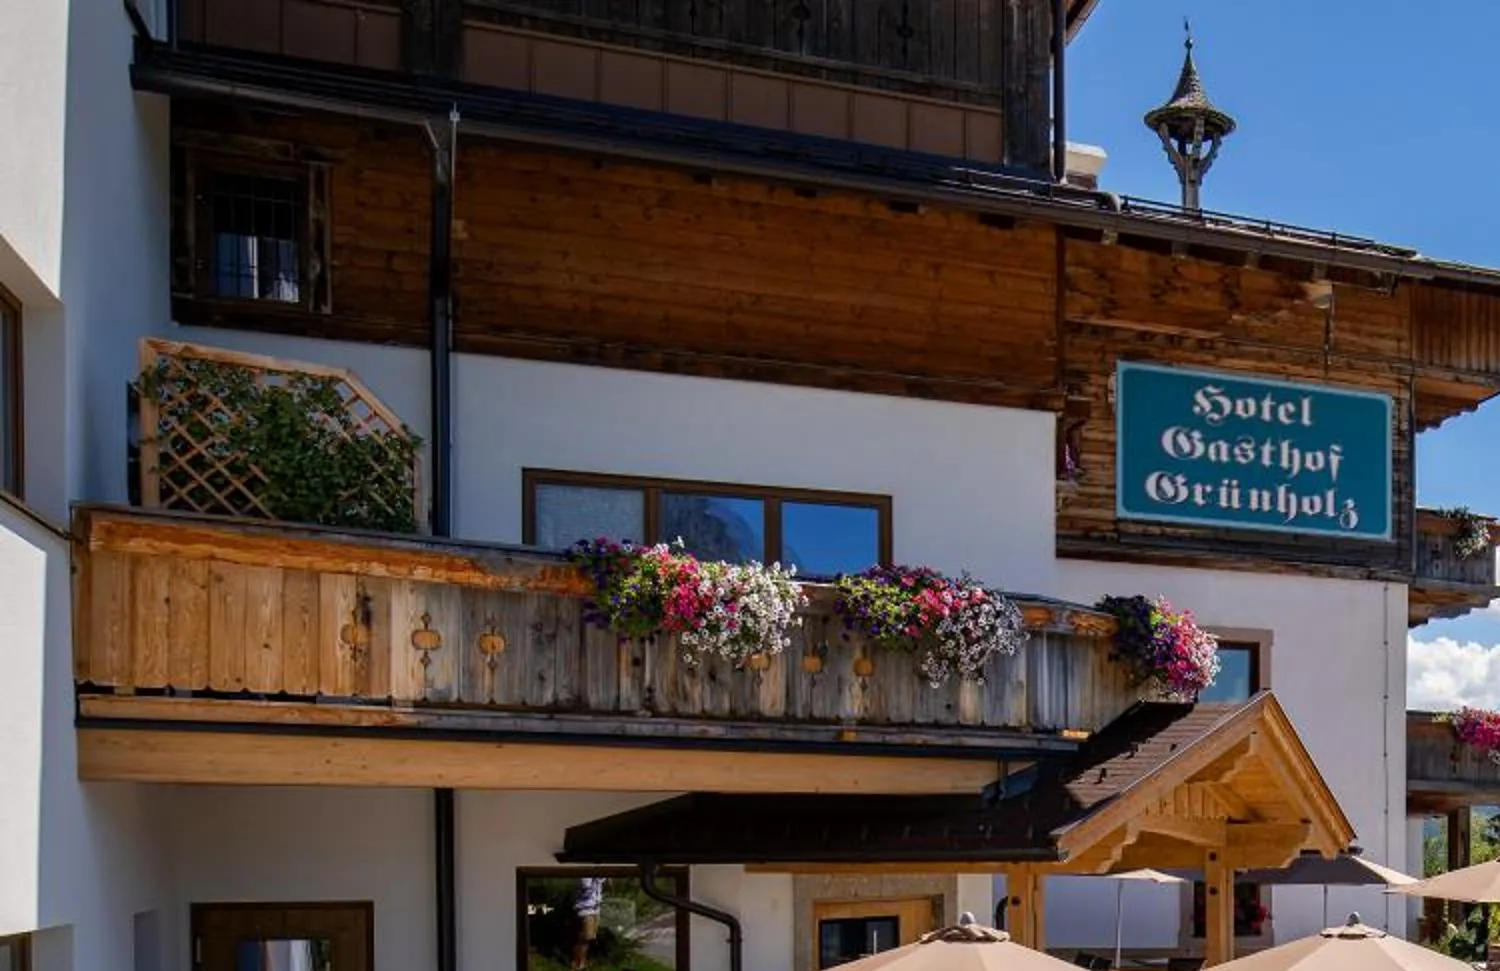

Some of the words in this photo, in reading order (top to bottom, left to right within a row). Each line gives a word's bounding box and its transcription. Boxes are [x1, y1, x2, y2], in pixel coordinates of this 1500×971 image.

[1192, 384, 1314, 427] Hotel
[1160, 425, 1344, 482] Gasthof
[1144, 470, 1359, 530] Grünholz
